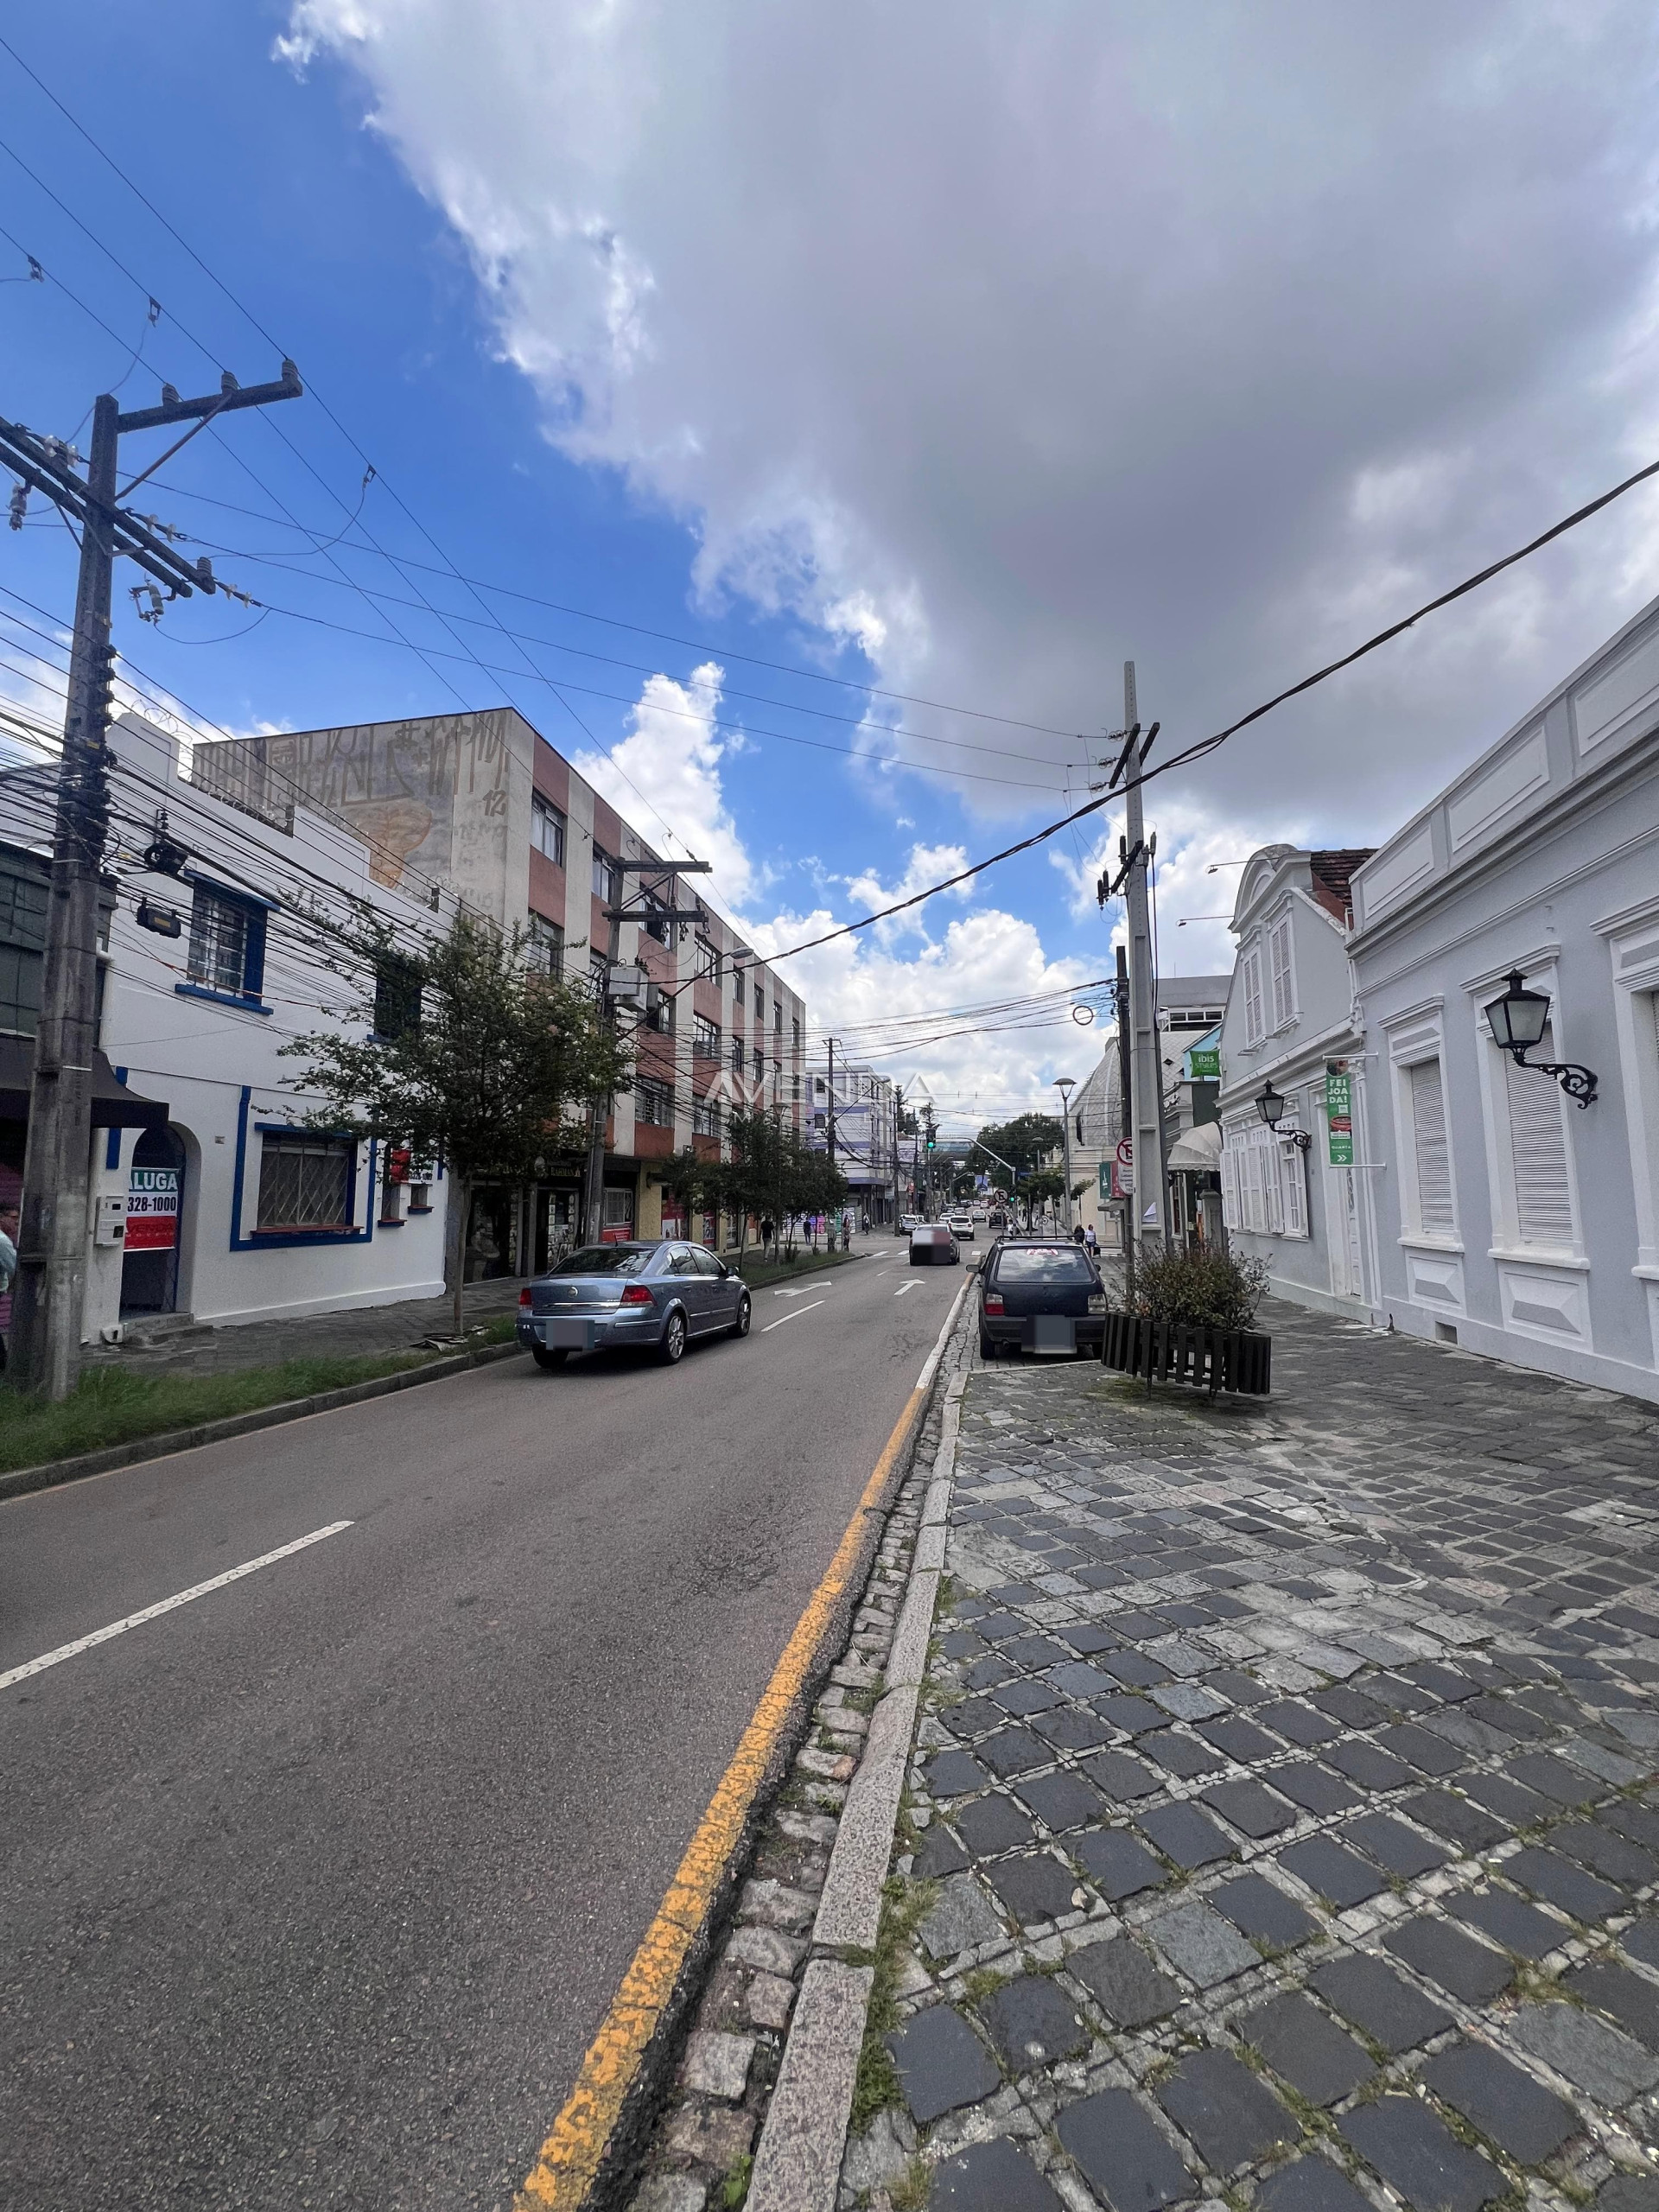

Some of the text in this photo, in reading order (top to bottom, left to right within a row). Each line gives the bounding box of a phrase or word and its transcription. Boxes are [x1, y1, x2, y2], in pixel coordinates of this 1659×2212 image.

[1329, 1078, 1346, 1087] FEI
[1328, 1096, 1348, 1104] DA!
[130, 1173, 178, 1190] LUGA
